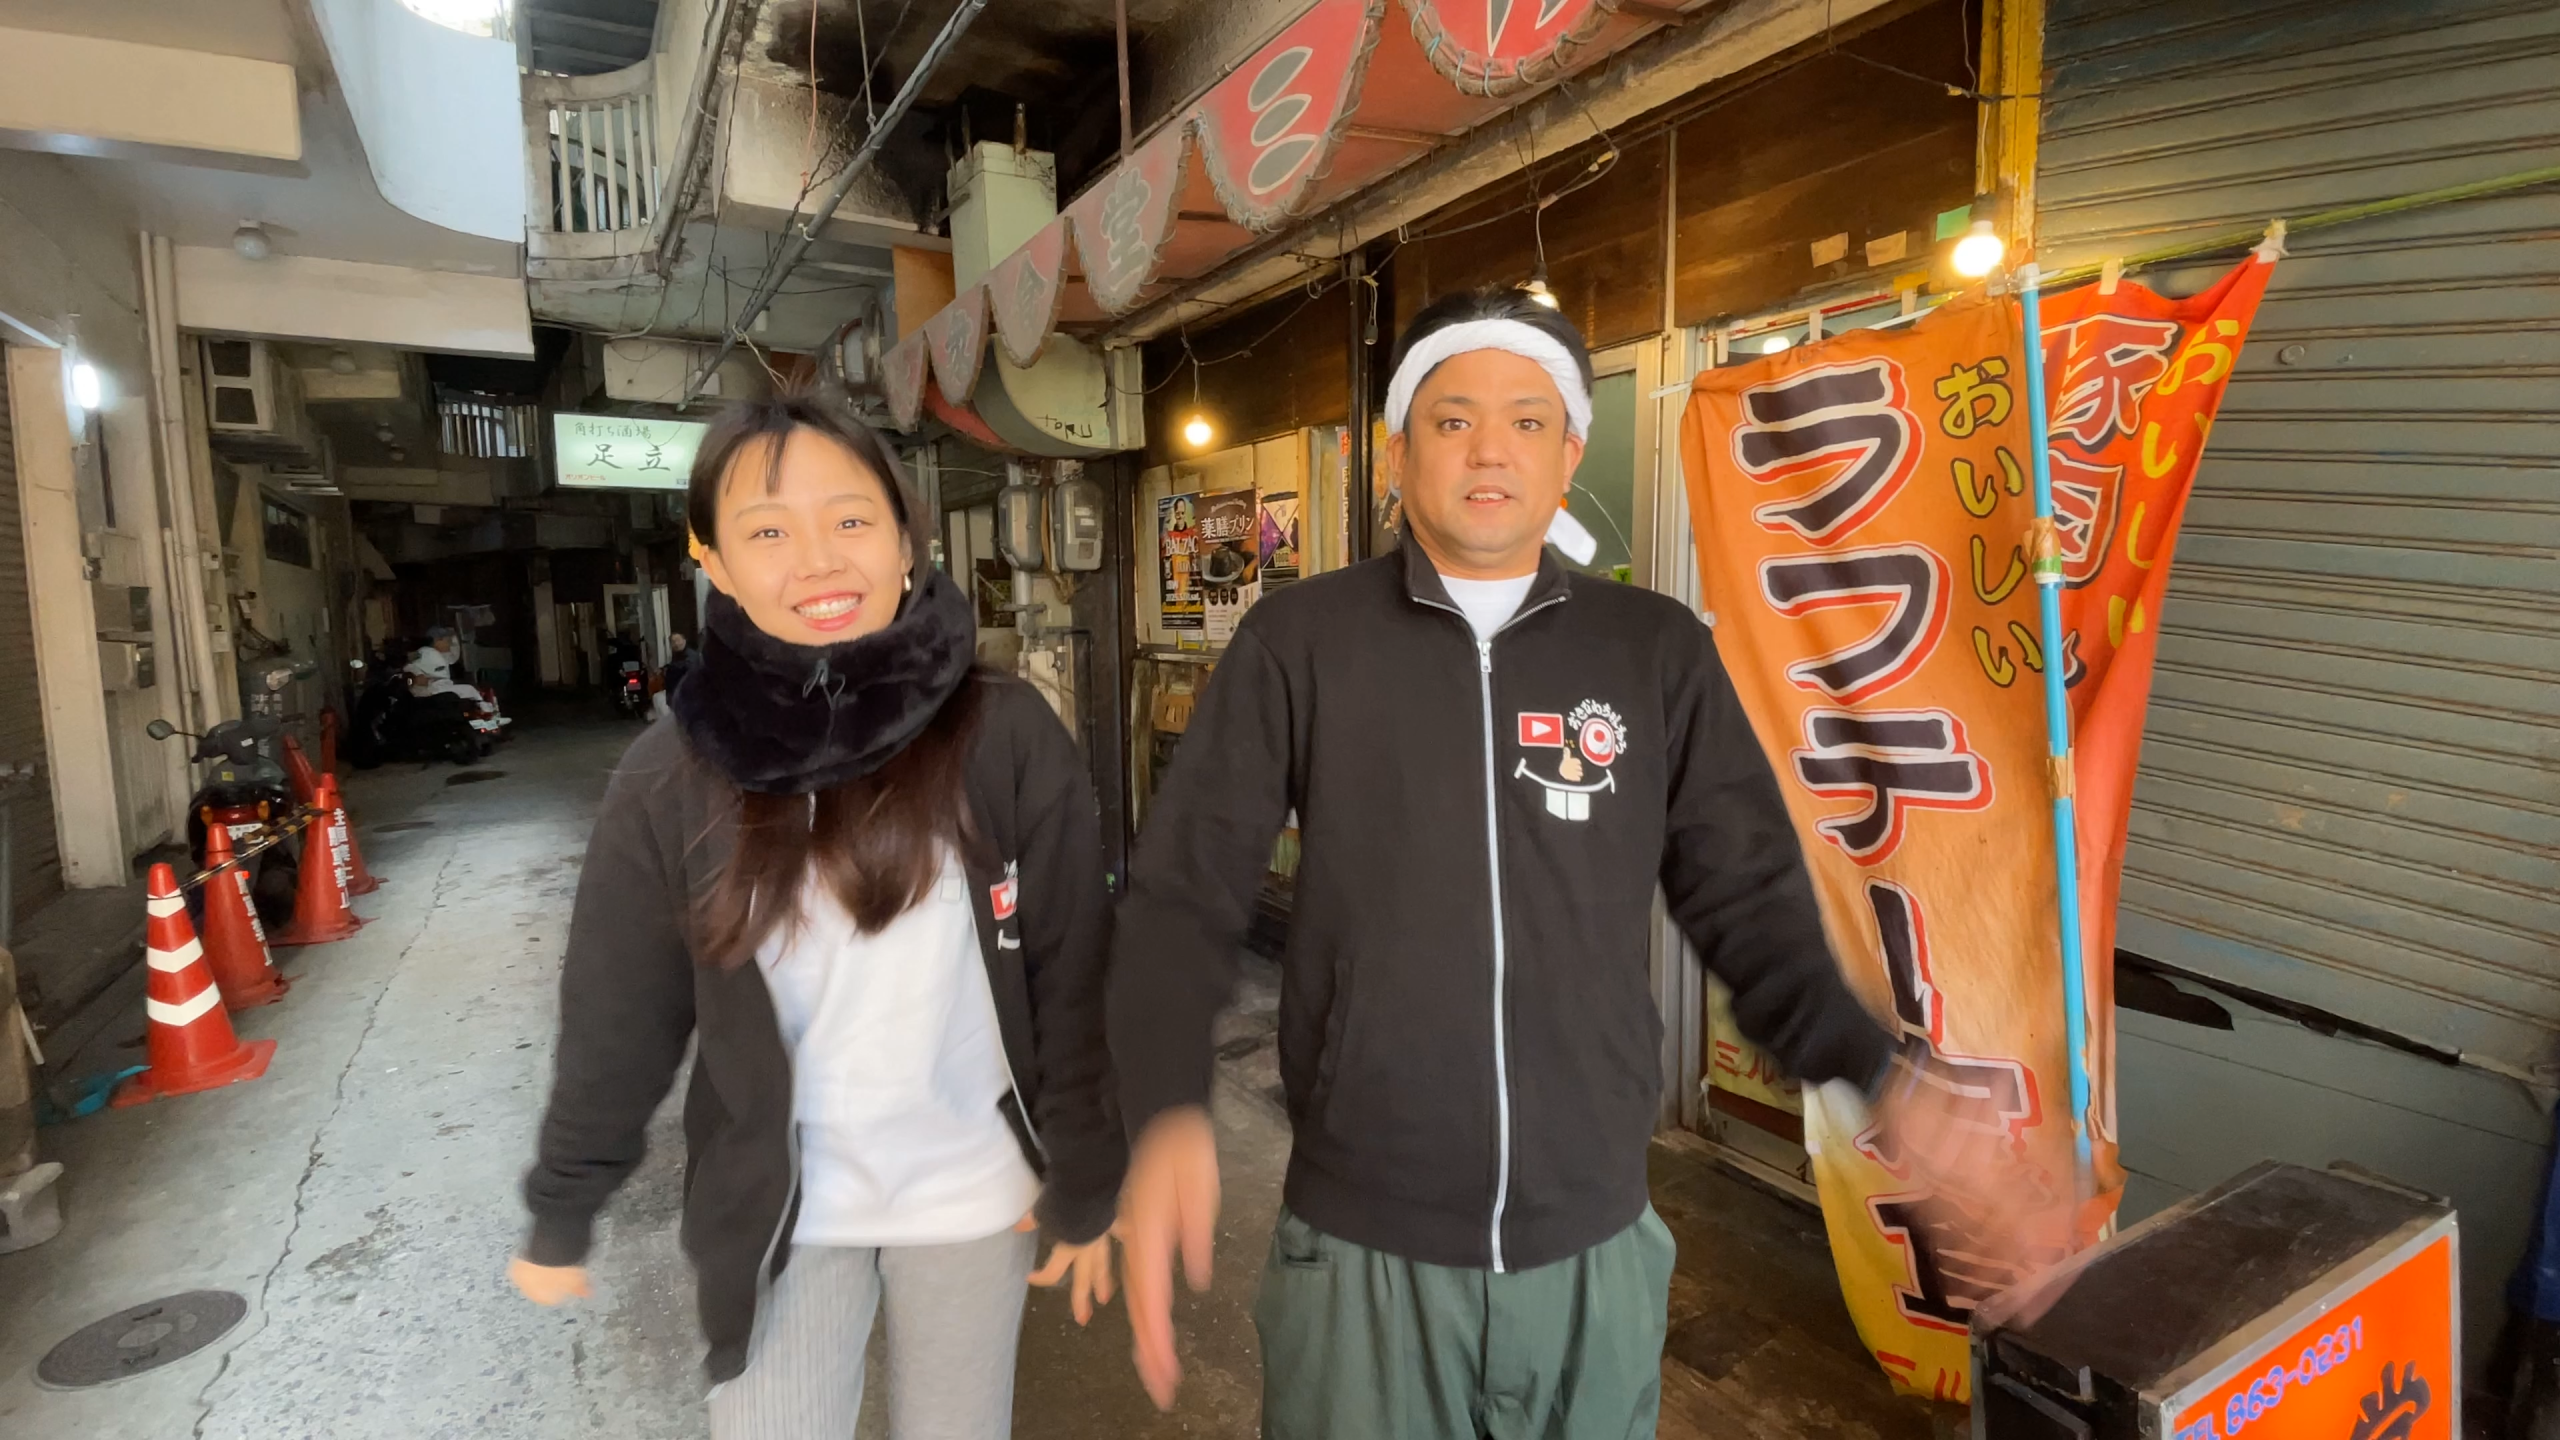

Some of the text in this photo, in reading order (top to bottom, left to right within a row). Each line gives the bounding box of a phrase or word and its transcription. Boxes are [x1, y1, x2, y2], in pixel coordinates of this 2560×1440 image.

[574, 421, 652, 439] 角打ち酒場
[586, 443, 671, 471] 足立
[2108, 319, 2240, 649] おいしい
[1201, 514, 1254, 539] 薬膳プリン
[1934, 356, 2043, 689] おいしい
[1164, 535, 1199, 558] BALZAC
[2225, 1314, 2364, 1436] 863-0231
